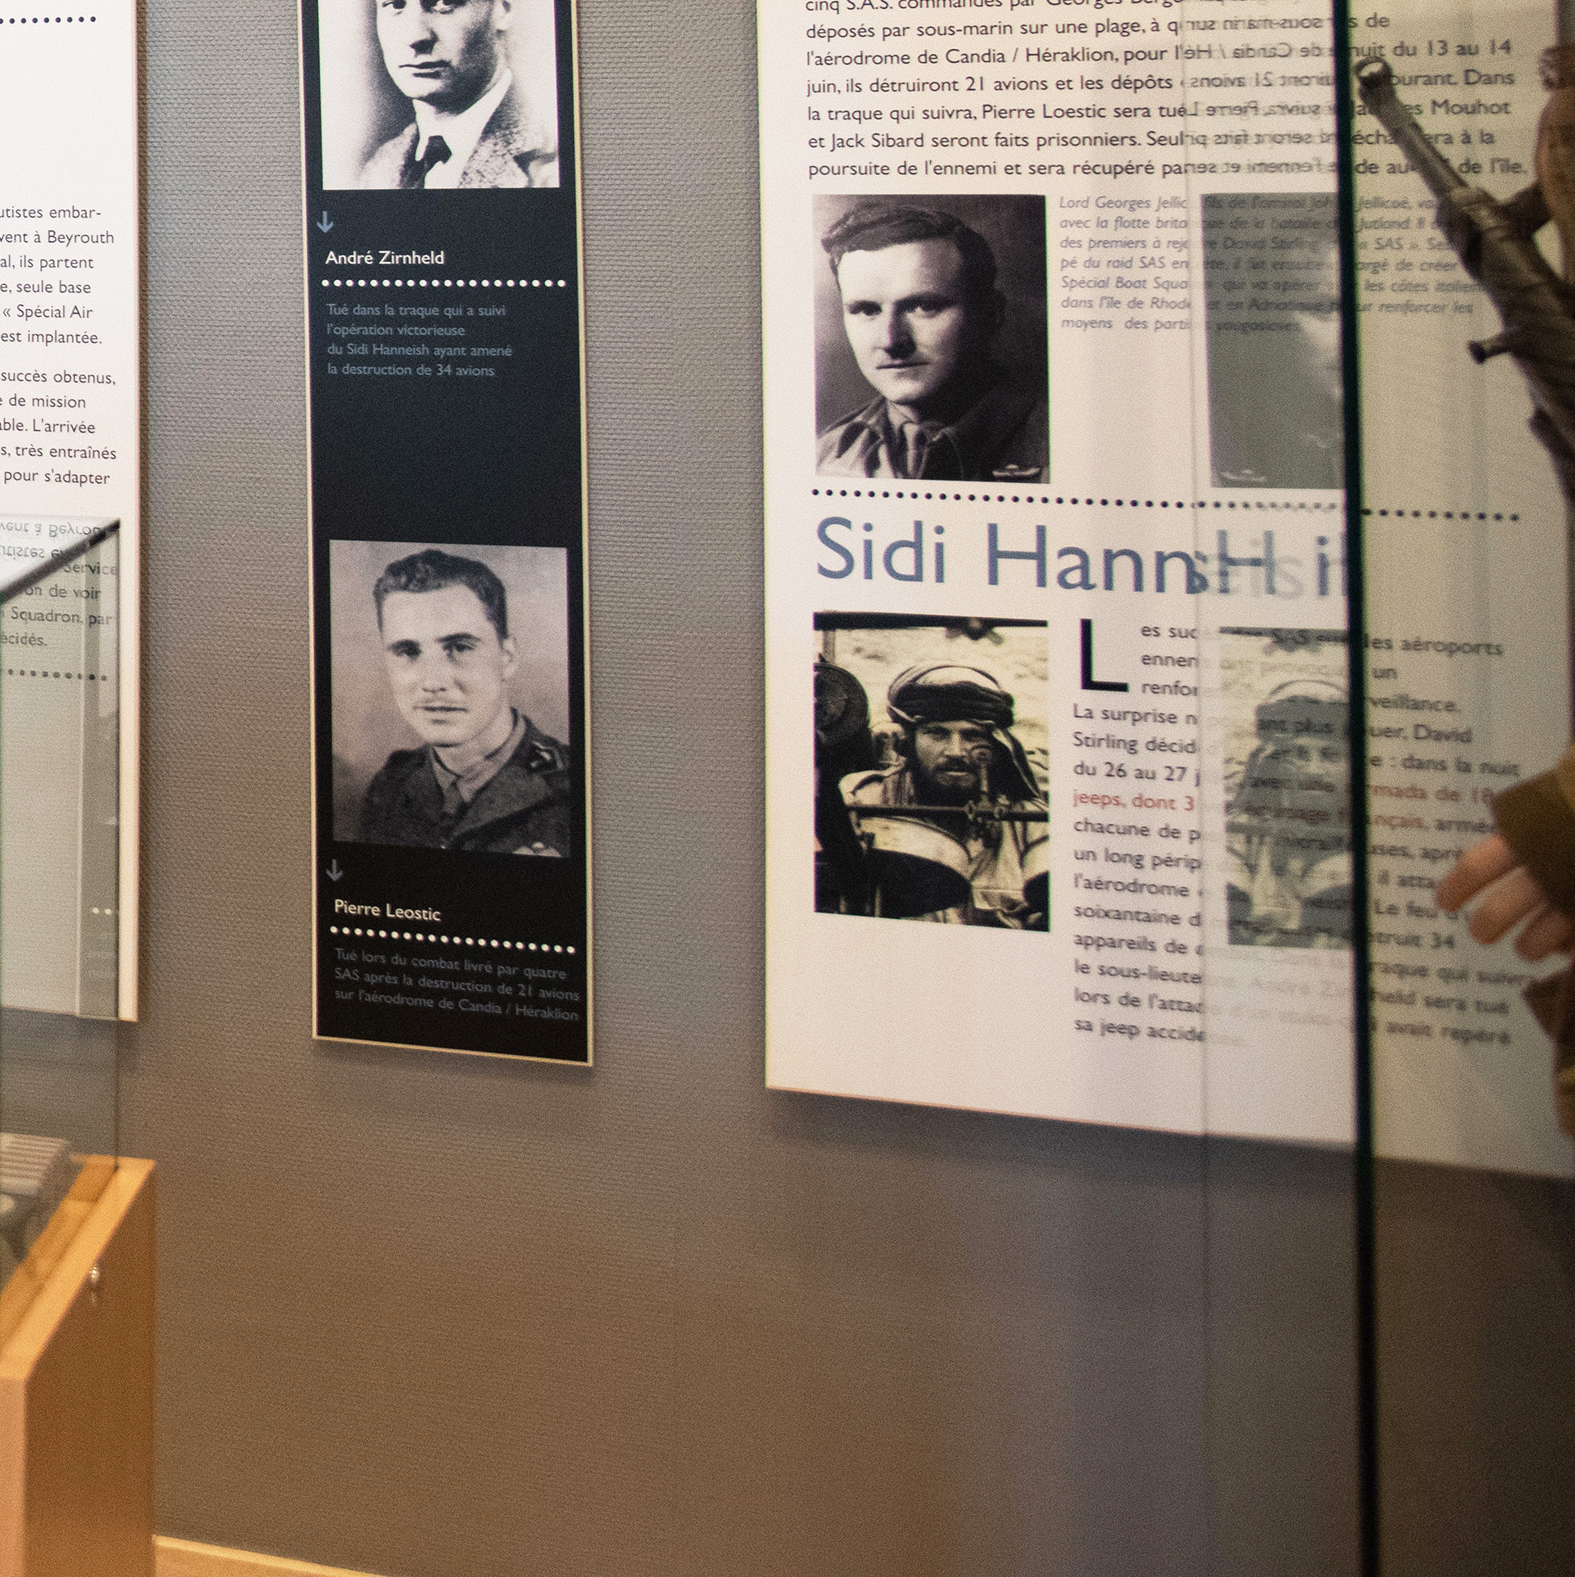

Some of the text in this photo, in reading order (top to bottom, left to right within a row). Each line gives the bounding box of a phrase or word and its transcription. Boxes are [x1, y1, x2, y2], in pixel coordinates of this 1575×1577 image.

[48, 204, 102, 220] embar-
[33, 230, 42, 245] à
[46, 228, 115, 248] Beyrouth
[325, 249, 445, 265] André Zirnheld
[326, 302, 507, 319] Tué dans la traque qui a suivi
[817, 517, 946, 585] Sidi
[1073, 759, 1189, 784] du 26 au 27
[1073, 790, 1195, 812] jeeps, dont 3
[334, 898, 440, 922] Pierre Leostic
